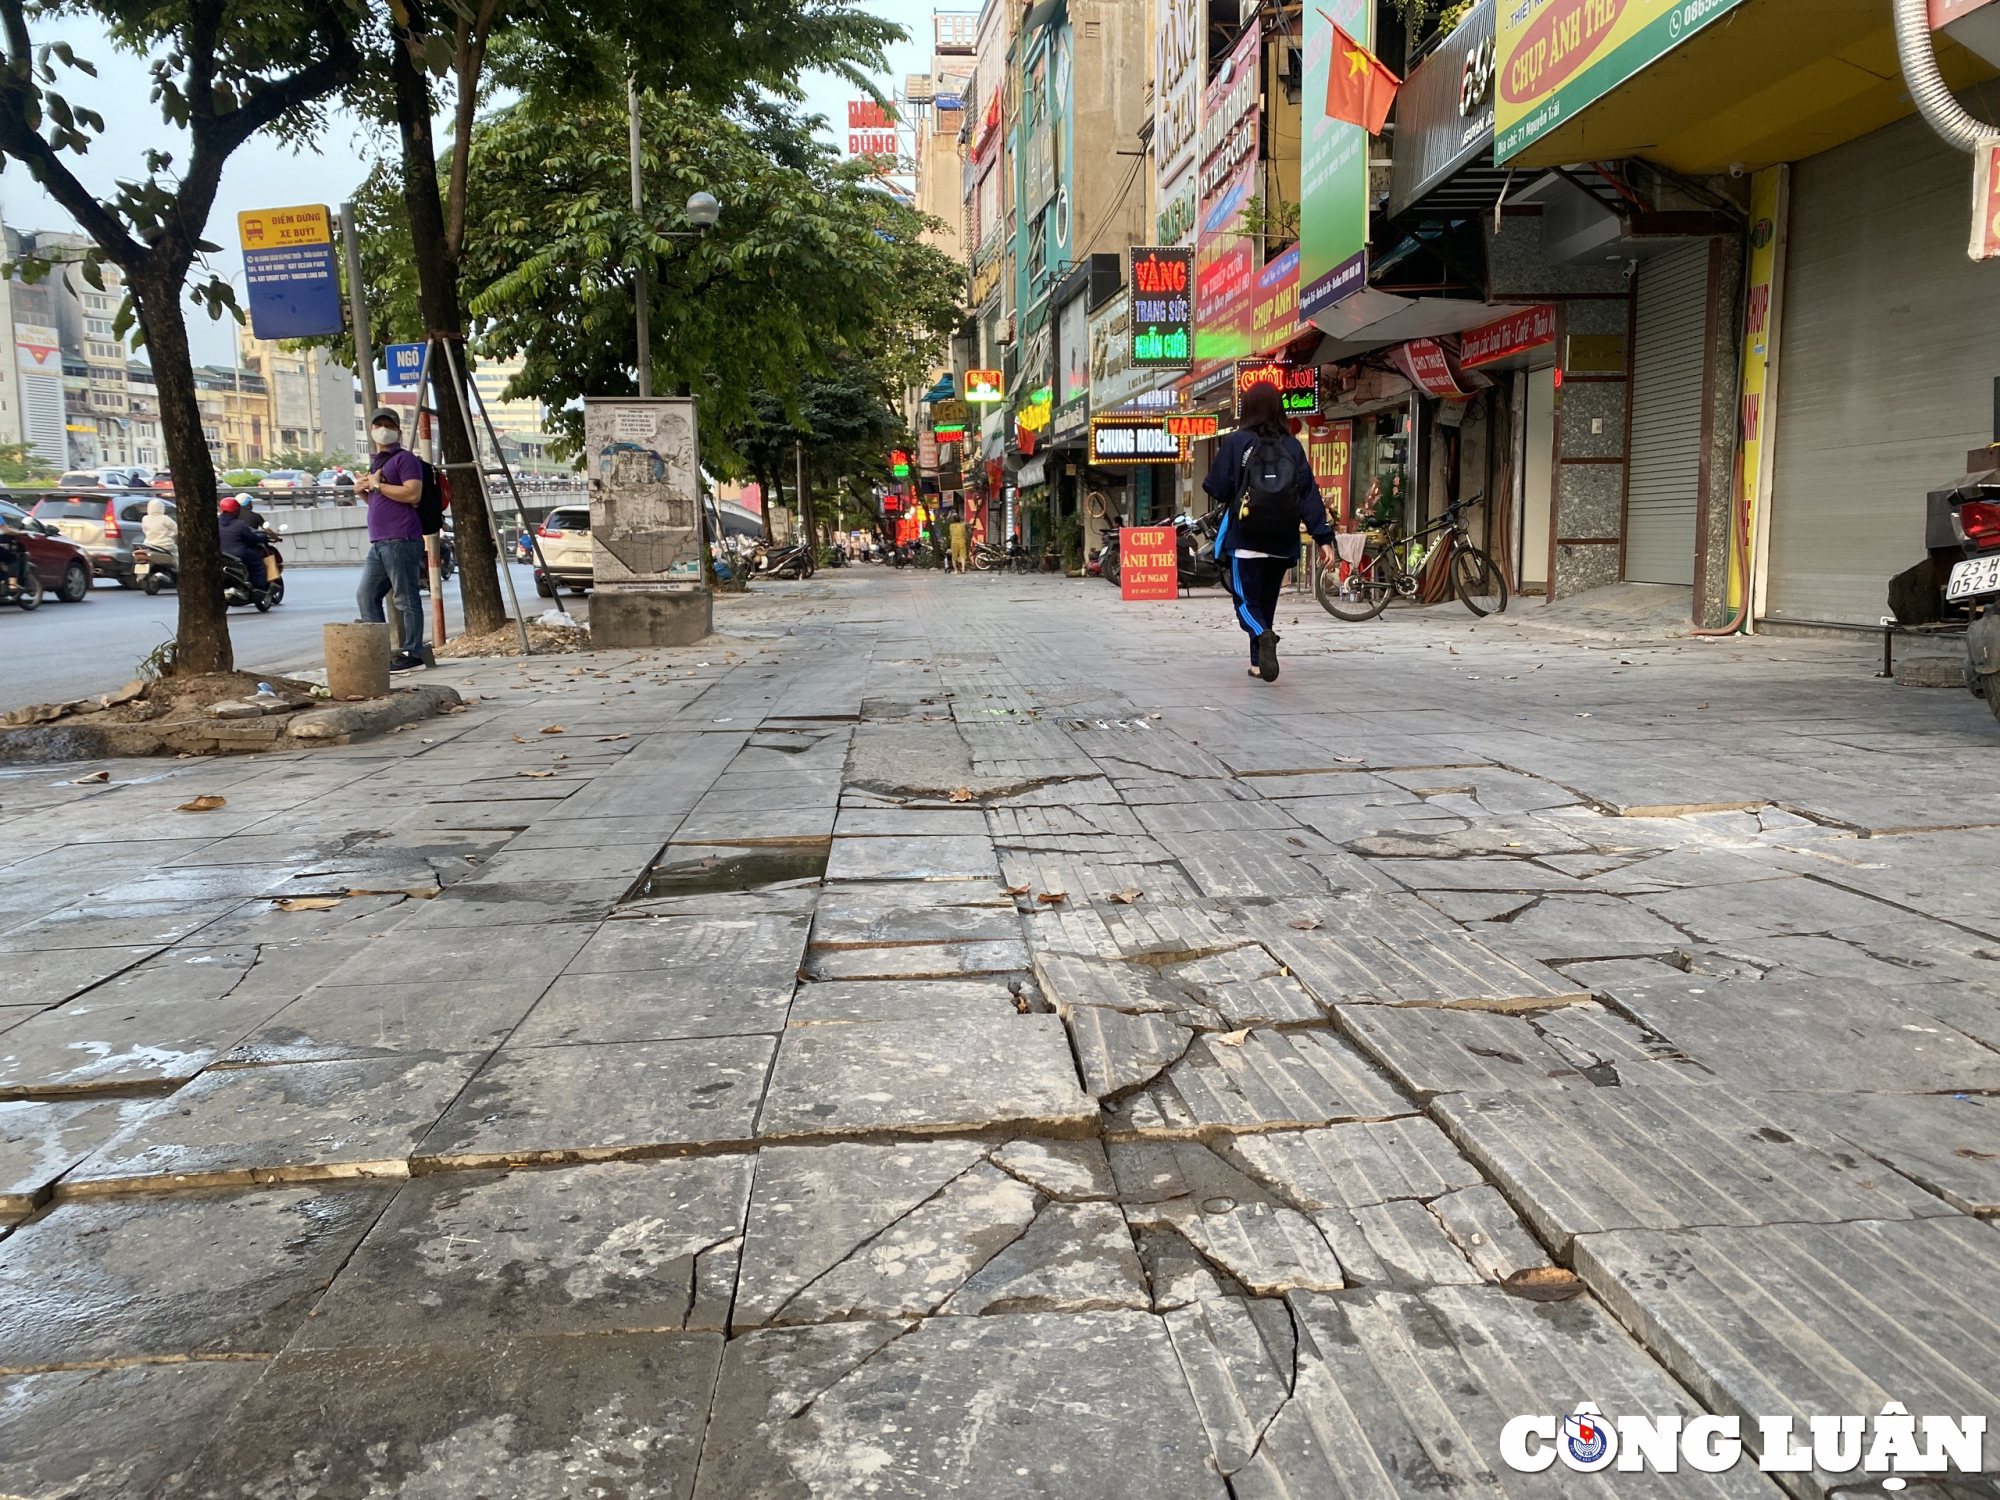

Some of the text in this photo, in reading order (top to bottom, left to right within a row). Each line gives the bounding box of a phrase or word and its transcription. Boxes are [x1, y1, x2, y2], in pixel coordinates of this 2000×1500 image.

[1512, 37, 1547, 95] CHỤP
[1549, 7, 1581, 68] ẢNH
[280, 225, 315, 238] XE BUÝT
[1135, 253, 1187, 292] VÀNG
[1136, 300, 1166, 322] TRANG
[1169, 294, 1188, 322] SỨC
[1253, 298, 1273, 331] CHỤP
[1274, 283, 1292, 319] ẢNH
[1135, 325, 1163, 359] NHẪN
[1164, 327, 1187, 359] CƯỚI
[1261, 329, 1274, 350] LẤY
[1274, 322, 1293, 343] NGAY
[397, 346, 419, 368] NGÕ
[1413, 351, 1444, 371] CHO THUÊ
[1461, 338, 1481, 363] Chuyên
[1168, 416, 1216, 435] VÀNG
[1096, 428, 1178, 453] CHUNG MOBILE
[1310, 431, 1348, 477] THIẾP
[1131, 532, 1165, 549] CHỤP
[1122, 549, 1176, 568] ẢNH THẺ
[1130, 571, 1169, 583] LẤY NGAY
